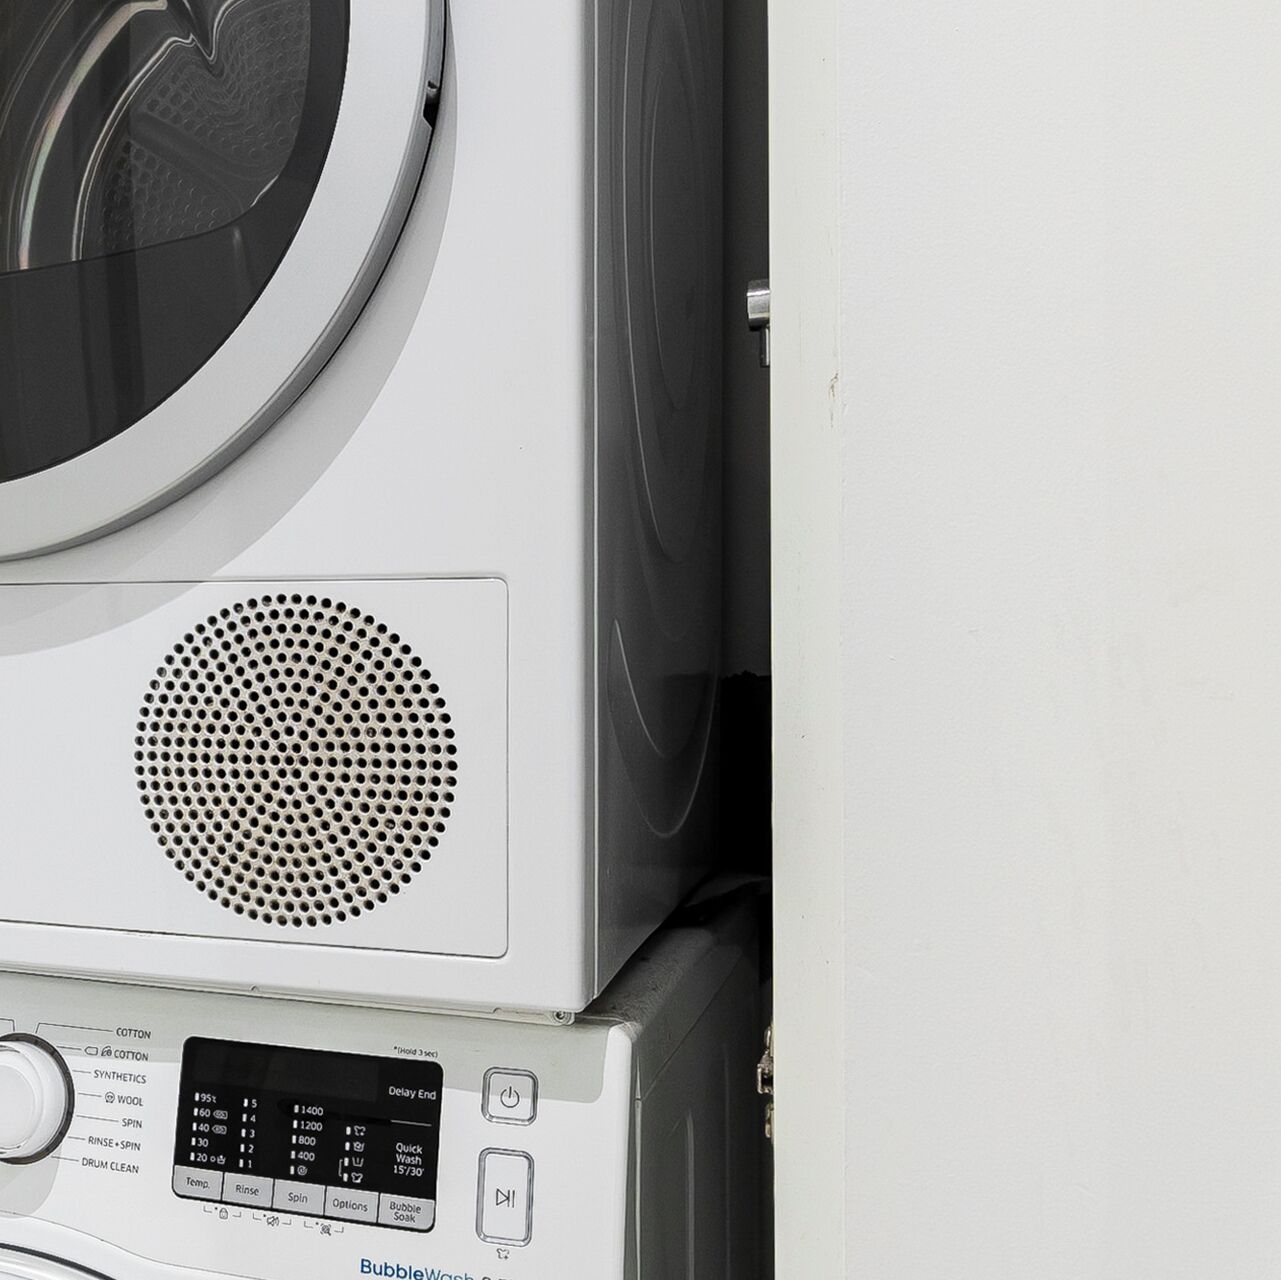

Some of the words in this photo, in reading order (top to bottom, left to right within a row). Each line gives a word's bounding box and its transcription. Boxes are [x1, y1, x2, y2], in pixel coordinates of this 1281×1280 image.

[116, 1027, 152, 1039] COTTON
[114, 1049, 149, 1061] COTTON
[94, 1069, 147, 1084] SYNTHETICS
[389, 1086, 416, 1100] Delay
[417, 1089, 437, 1100] End
[117, 1095, 144, 1107] WOOL
[251, 1099, 257, 1108] 5
[199, 1108, 211, 1118] 60
[301, 1106, 323, 1116] 1400
[122, 1118, 143, 1129] SPIN
[250, 1114, 256, 1123] 4
[198, 1123, 210, 1133] 40
[300, 1121, 323, 1131] 1200
[249, 1129, 255, 1138] 3
[197, 1138, 209, 1147] 30
[298, 1136, 316, 1146] 800
[248, 1144, 254, 1153] 2
[396, 1142, 423, 1155] Quick
[196, 1153, 208, 1162] 20
[297, 1151, 315, 1161] 400
[396, 1154, 422, 1165] Wash
[82, 1157, 108, 1170] DRUM
[109, 1161, 139, 1174] CLEAN
[186, 1177, 210, 1190] Temp.
[235, 1185, 260, 1196] Rinse
[288, 1193, 308, 1206] Spin
[332, 1198, 368, 1213] Options
[389, 1201, 422, 1214] Bubble
[393, 1212, 416, 1224] Soak
